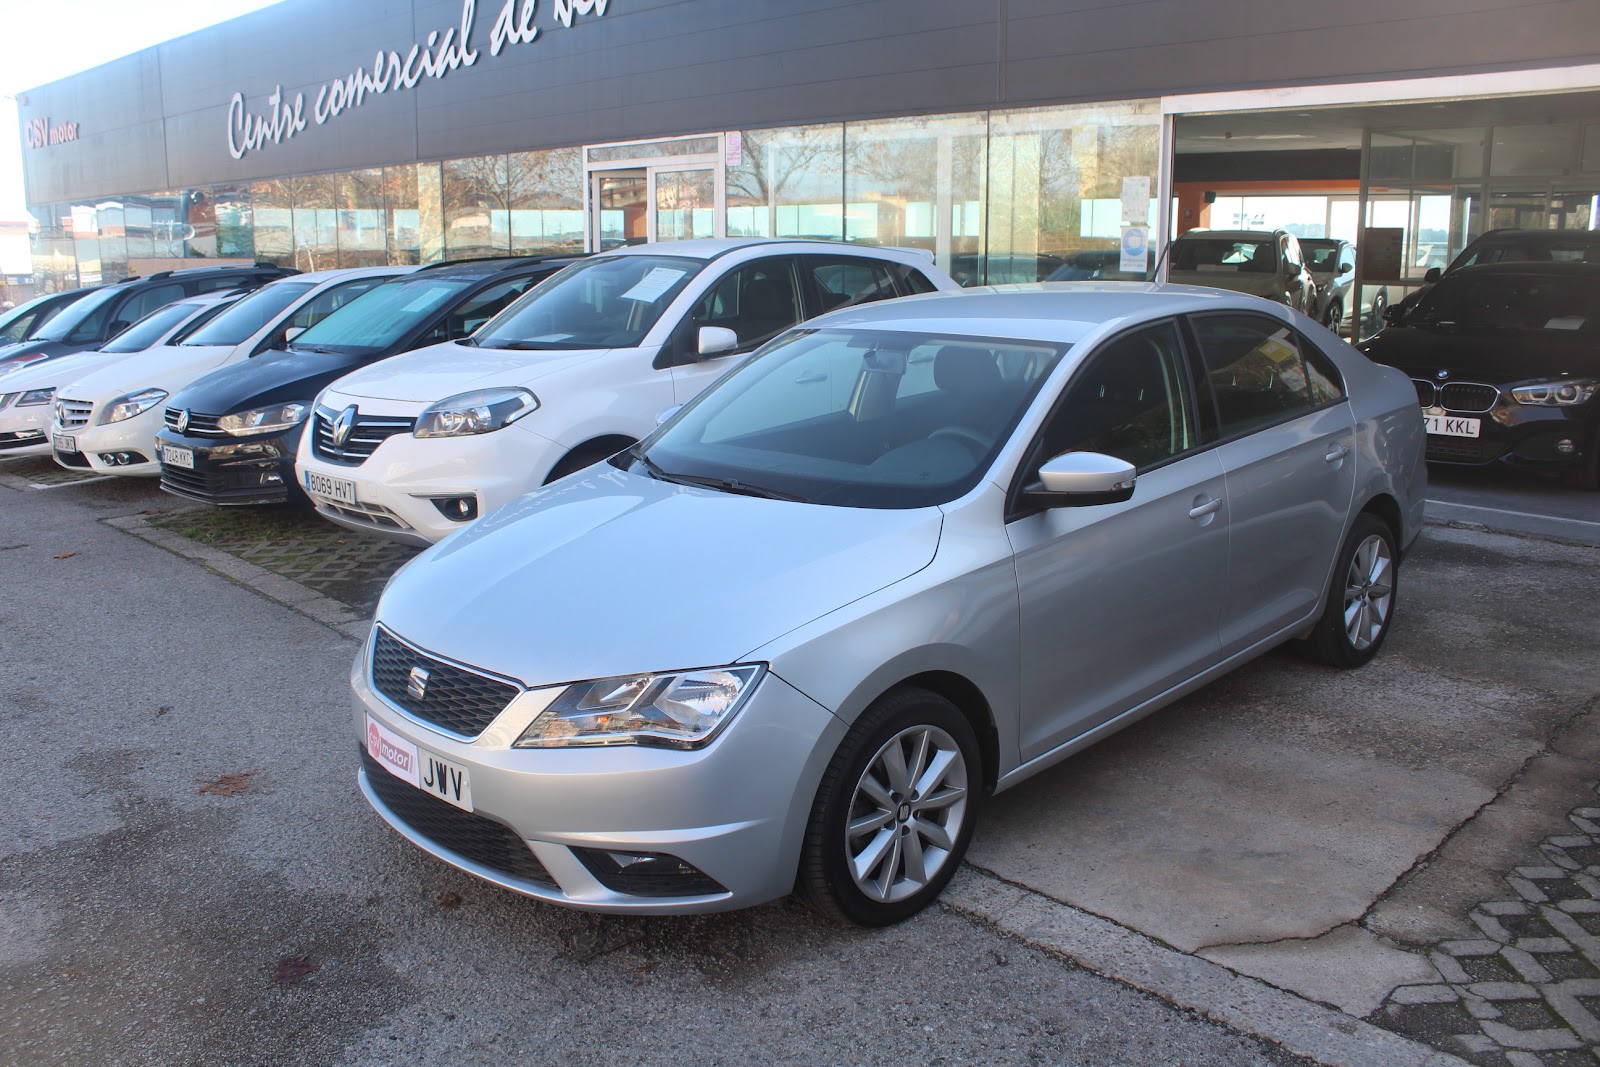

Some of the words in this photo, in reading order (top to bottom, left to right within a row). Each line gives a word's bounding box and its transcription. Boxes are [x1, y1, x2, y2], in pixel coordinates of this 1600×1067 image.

[227, 84, 306, 160] Centre
[315, 0, 477, 124] comercial
[490, 0, 537, 56] de
[25, 116, 49, 149] CSV
[50, 121, 79, 145] motor
[1446, 420, 1474, 434] KKL
[311, 475, 332, 495] 8069
[335, 480, 352, 500] HVT
[381, 744, 409, 767] motor
[424, 757, 462, 801] JWV
